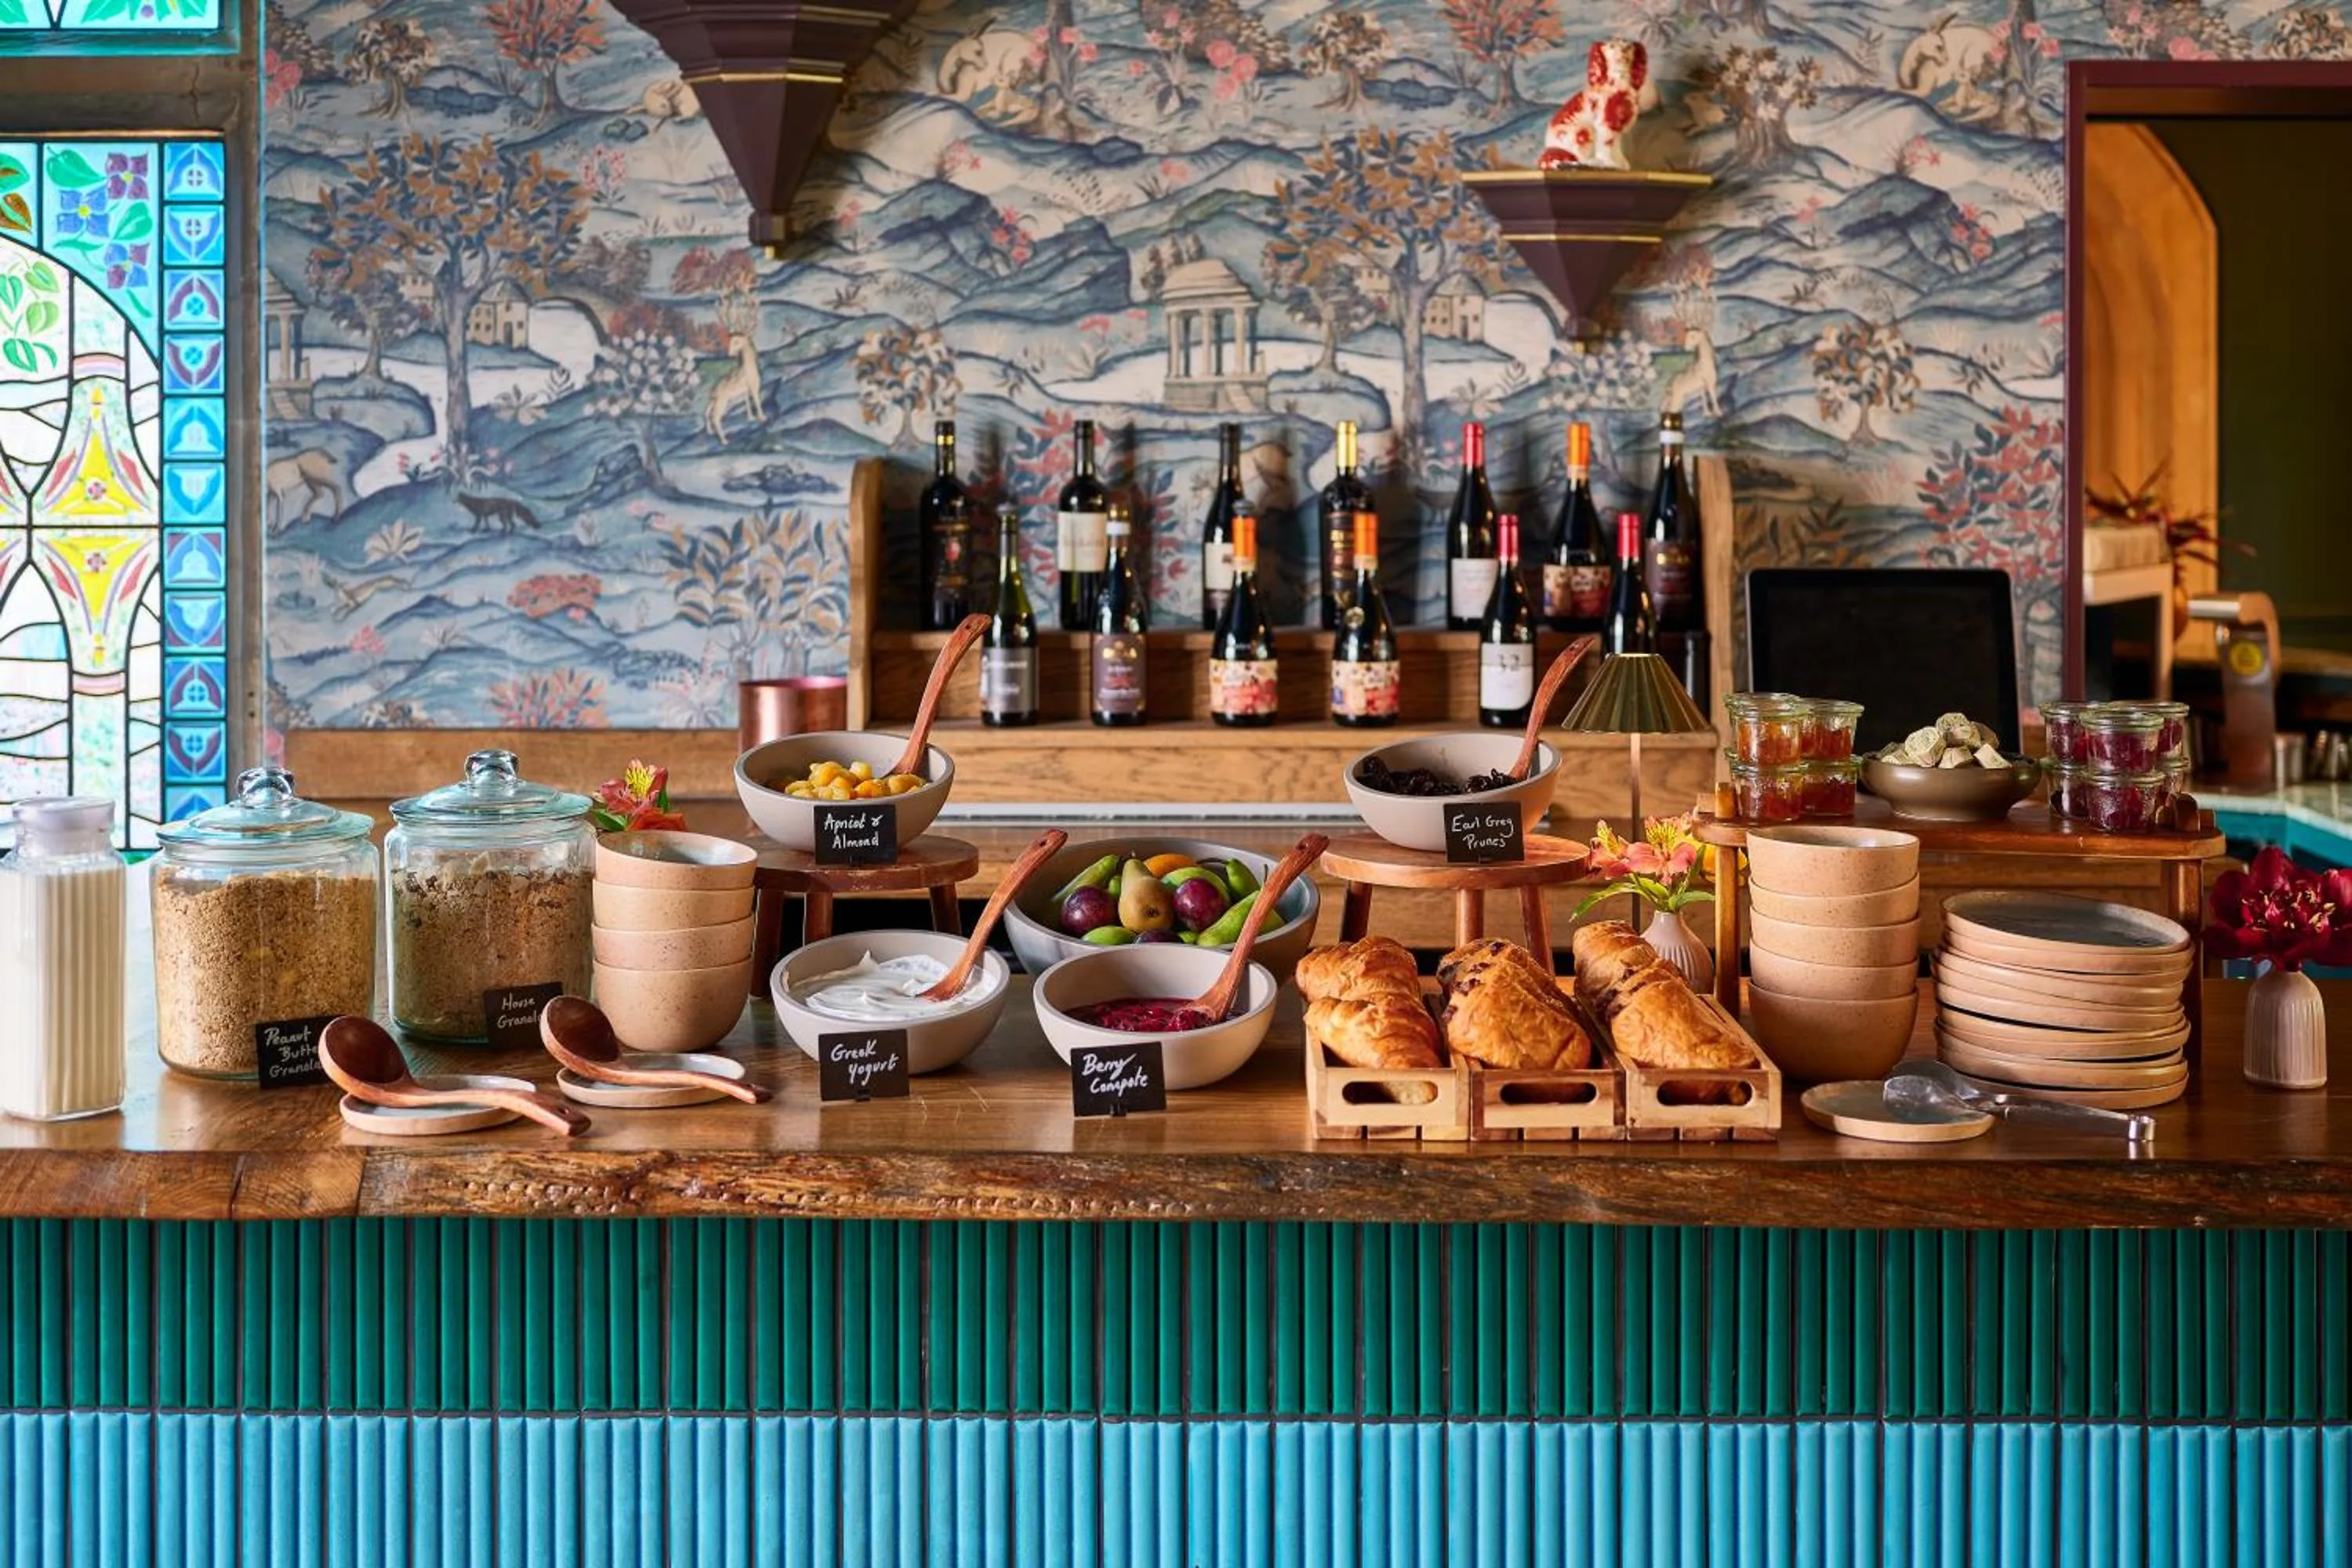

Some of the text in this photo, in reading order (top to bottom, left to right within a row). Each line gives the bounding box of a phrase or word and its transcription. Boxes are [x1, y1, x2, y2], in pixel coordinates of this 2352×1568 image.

[824, 812, 866, 834] Apricot
[1451, 813, 1480, 833] Earl
[832, 831, 880, 850] Almond
[1462, 833, 1506, 851] Prunes
[501, 992, 535, 1011] House
[263, 1025, 312, 1047] Peanut
[278, 1044, 318, 1062] Butte
[831, 1039, 877, 1062] Greek
[1082, 1053, 1138, 1080] Berry
[1090, 1065, 1149, 1098] Compote
